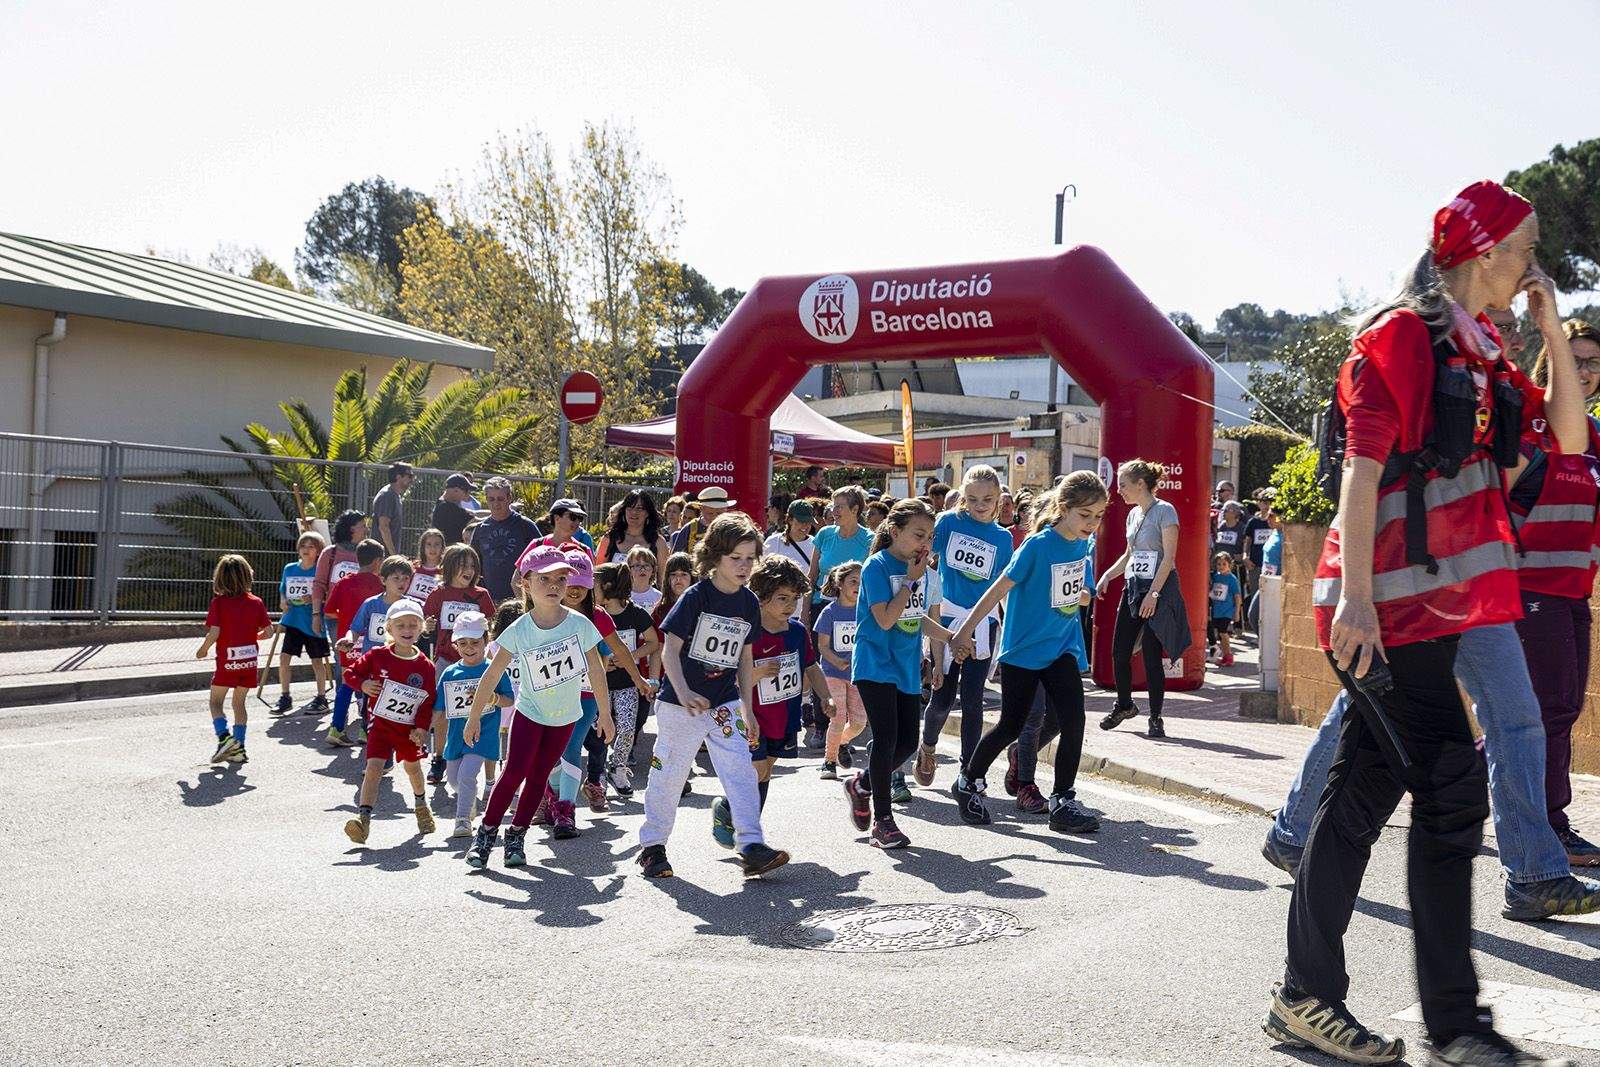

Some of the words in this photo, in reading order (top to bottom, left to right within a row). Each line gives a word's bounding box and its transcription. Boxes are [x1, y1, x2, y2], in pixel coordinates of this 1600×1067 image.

[870, 273, 993, 306] Diputació
[870, 307, 994, 333] Barcelona
[683, 460, 735, 472] Diputació
[683, 472, 734, 484] Barcelona
[954, 549, 985, 568] 086
[1130, 562, 1149, 573] 122
[289, 586, 308, 595] 075
[415, 582, 434, 595] 125
[536, 653, 545, 661] EN
[547, 645, 569, 658] MARXA
[705, 636, 739, 657] 010
[539, 655, 574, 680] 171
[770, 671, 798, 692] 120
[385, 698, 415, 716] 224
